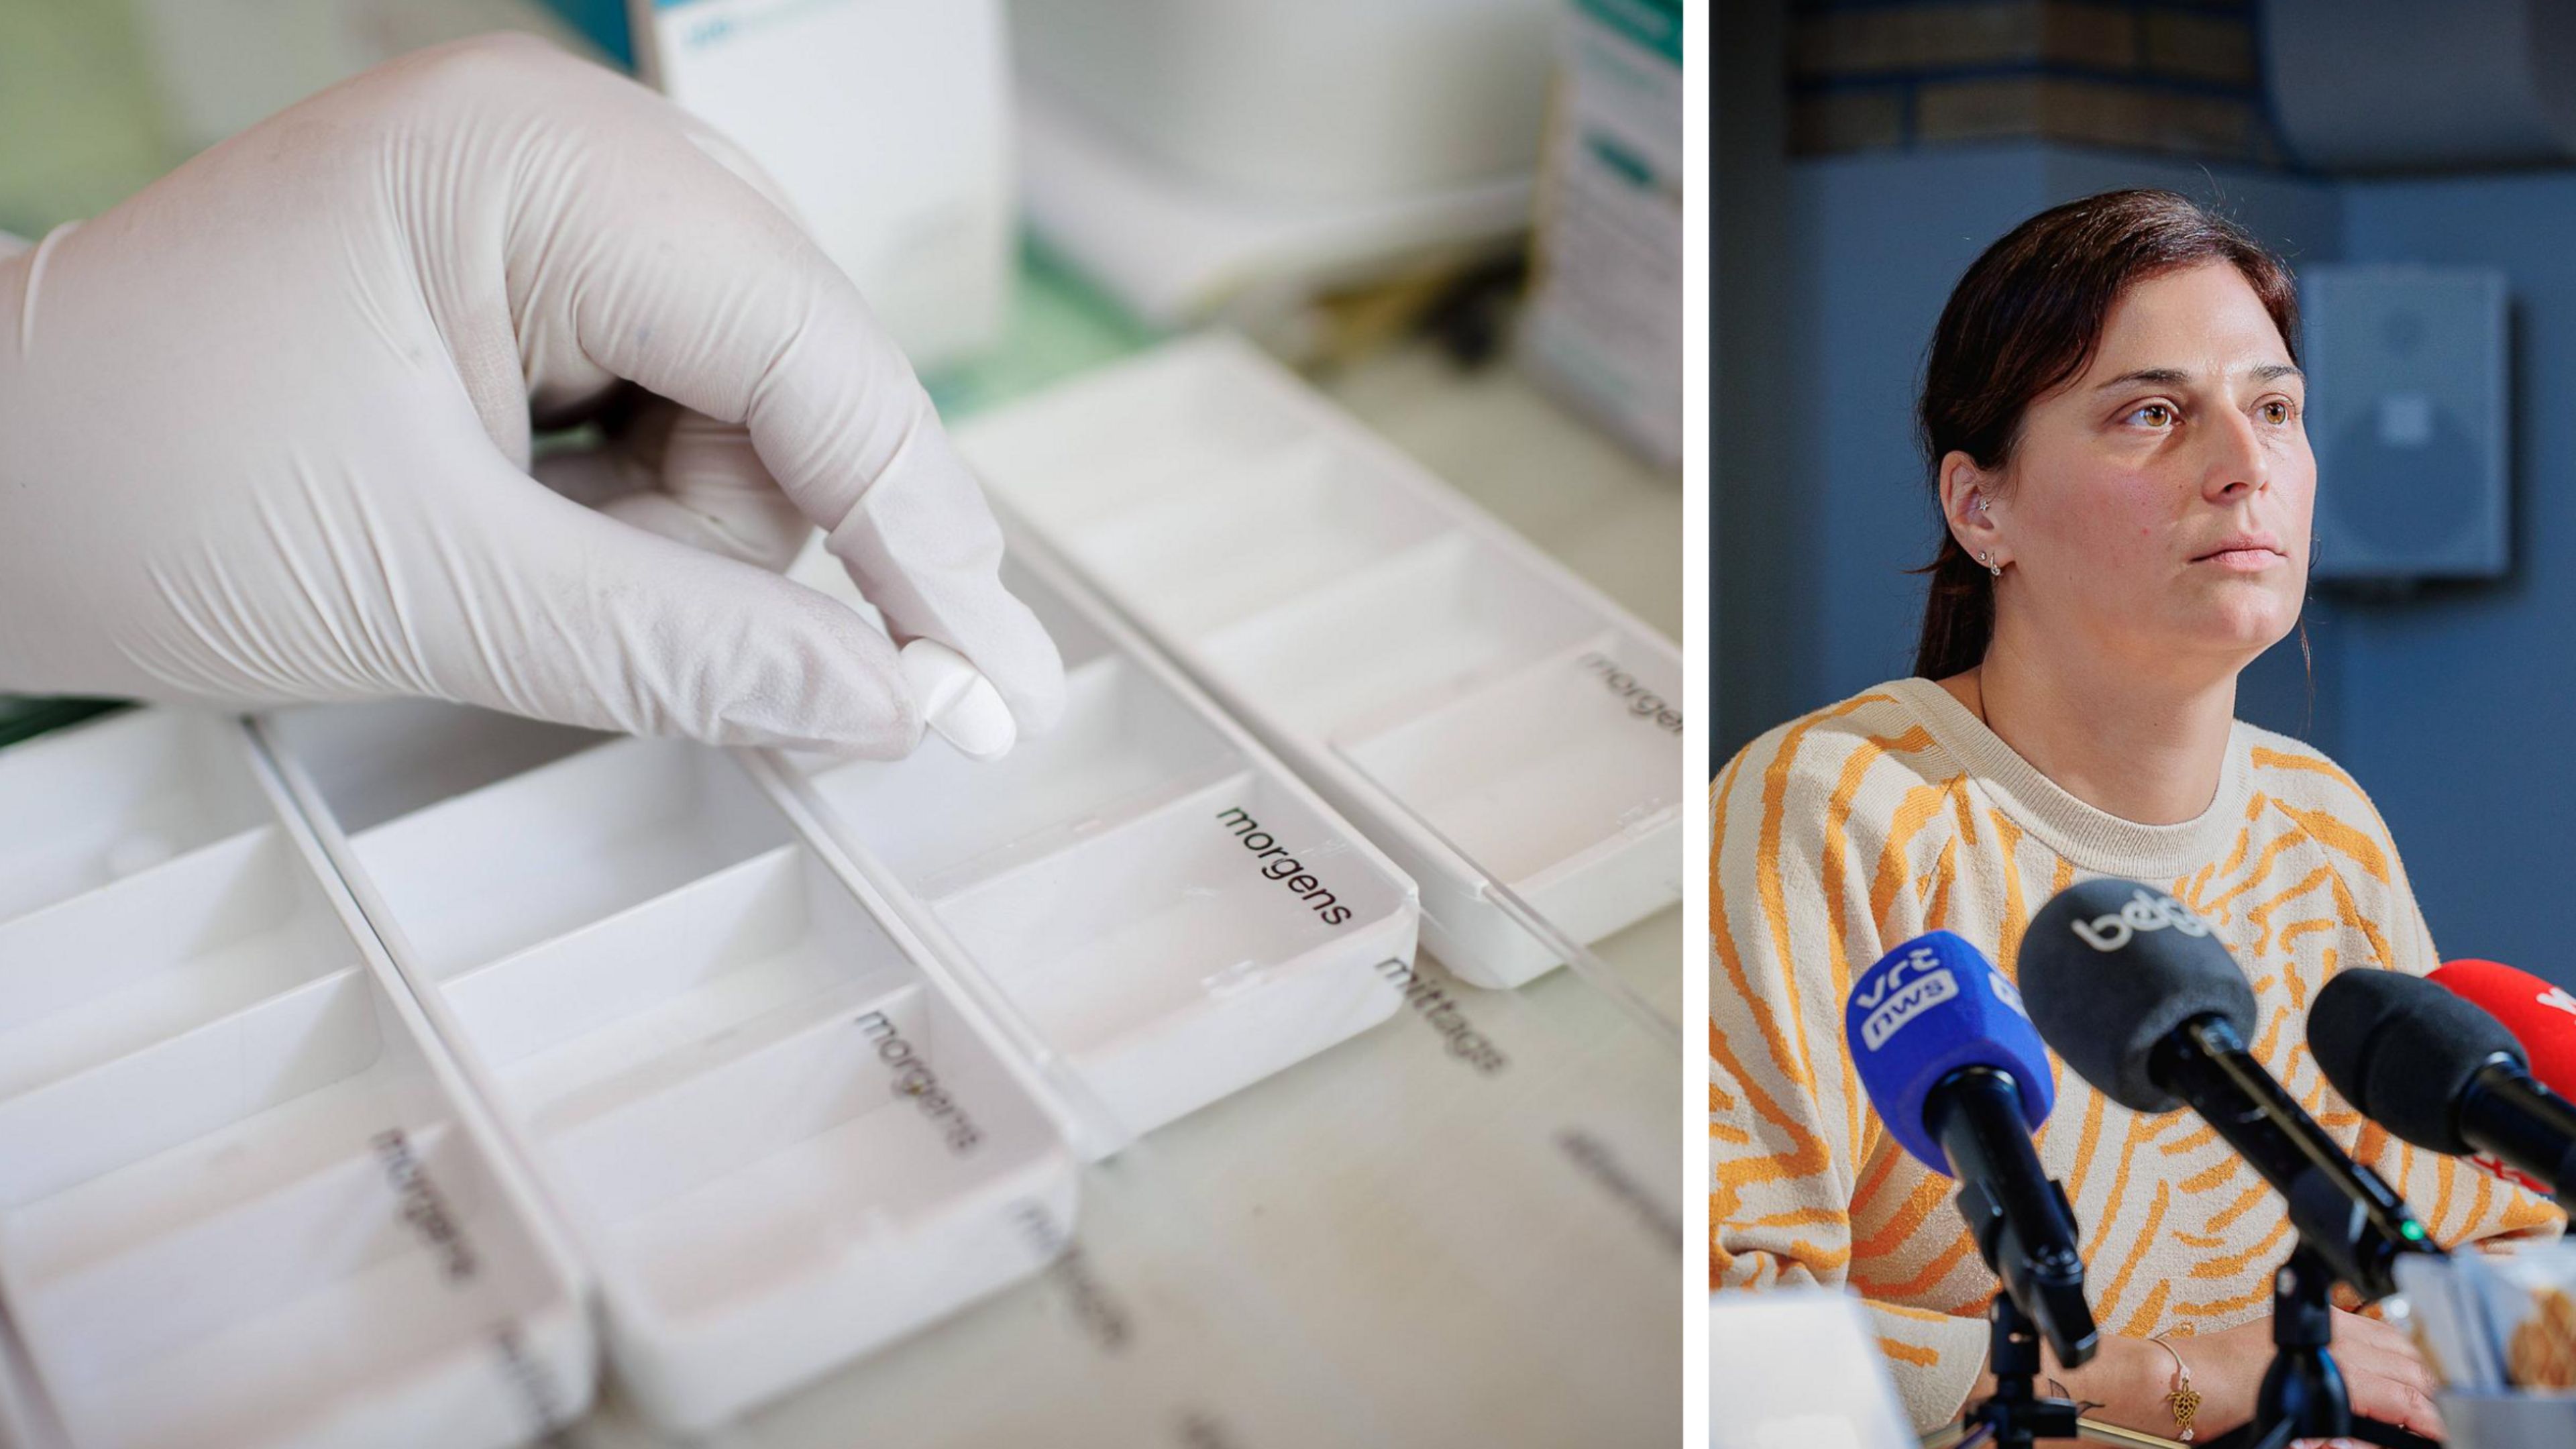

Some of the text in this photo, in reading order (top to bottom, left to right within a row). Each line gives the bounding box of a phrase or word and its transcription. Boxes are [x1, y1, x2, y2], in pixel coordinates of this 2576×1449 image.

[1216, 806, 1352, 926] morgens
[1374, 957, 1507, 1076] mittags
[1871, 979, 1945, 1036] nws
[854, 1010, 985, 1155] morgens
